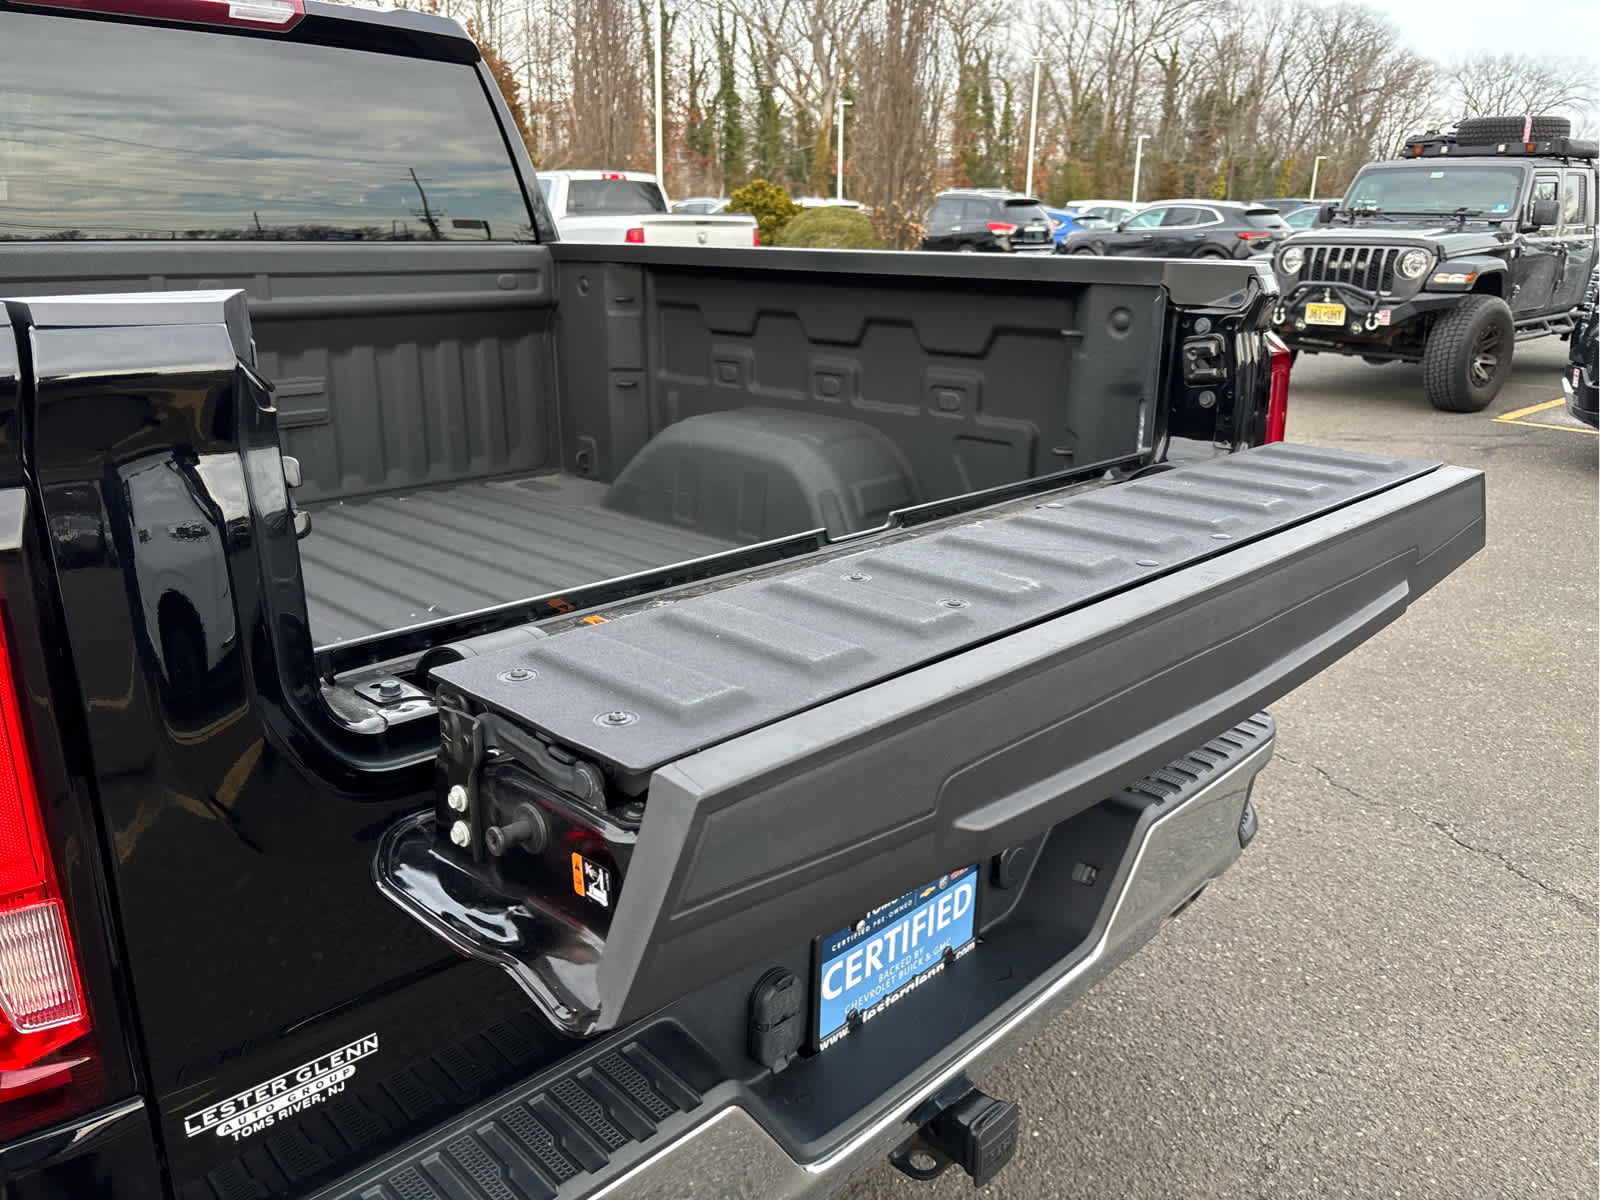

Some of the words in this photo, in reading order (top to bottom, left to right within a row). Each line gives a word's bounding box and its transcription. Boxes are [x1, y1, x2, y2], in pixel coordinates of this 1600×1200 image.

[822, 883, 972, 1000] CERTIFIED
[878, 954, 912, 983] BACKED
[914, 946, 925, 958] BY
[844, 974, 896, 1014] CHEVROLET
[899, 959, 923, 980] BUICK
[184, 1078, 292, 1134] LESTER
[296, 1035, 379, 1082] GLENN
[223, 1104, 274, 1132] AUTO
[287, 1068, 351, 1102] GROUP
[231, 1116, 275, 1141] TOMS
[278, 1093, 326, 1120] RIVER,
[327, 1082, 345, 1096] NJ
